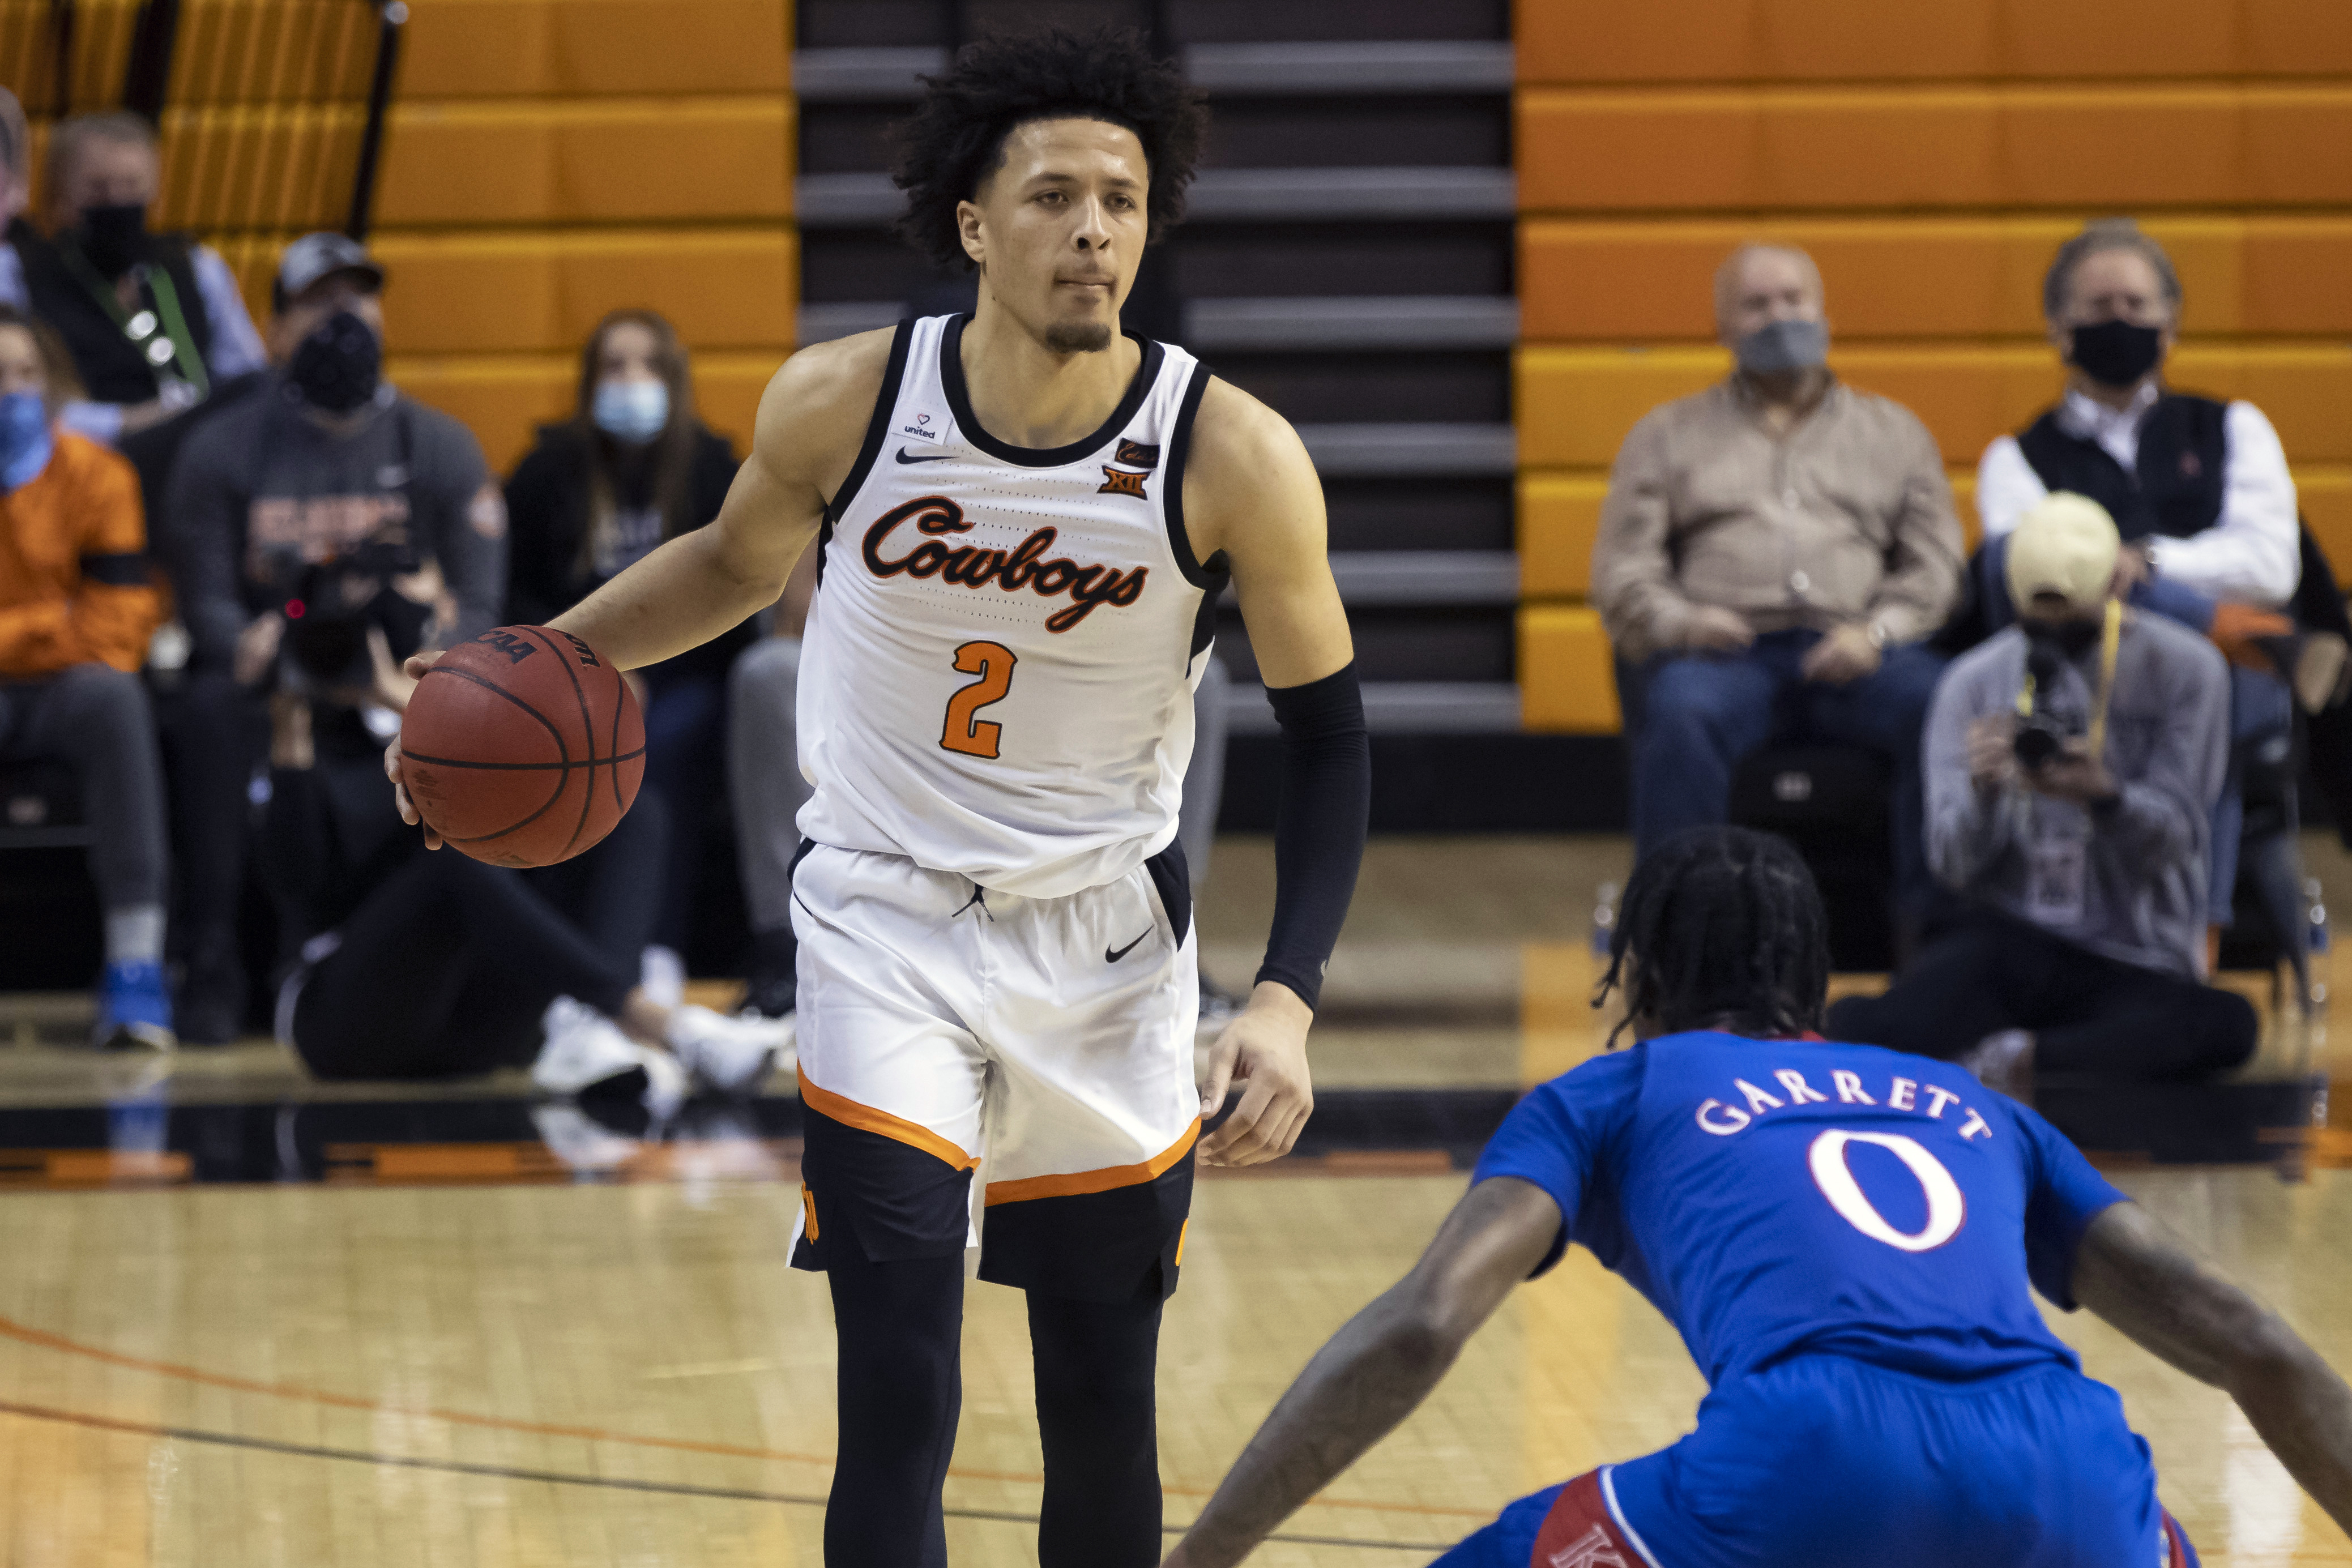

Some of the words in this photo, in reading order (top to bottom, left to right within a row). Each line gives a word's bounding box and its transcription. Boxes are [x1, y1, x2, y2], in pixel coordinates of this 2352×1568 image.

[904, 425, 936, 439] united
[1098, 466, 1147, 499] XII
[861, 495, 1149, 634] Cowboys
[473, 630, 537, 664] CAA
[938, 640, 1018, 759] 2
[1695, 1068, 1993, 1141] GARRETT
[1808, 1129, 1967, 1253] 0
